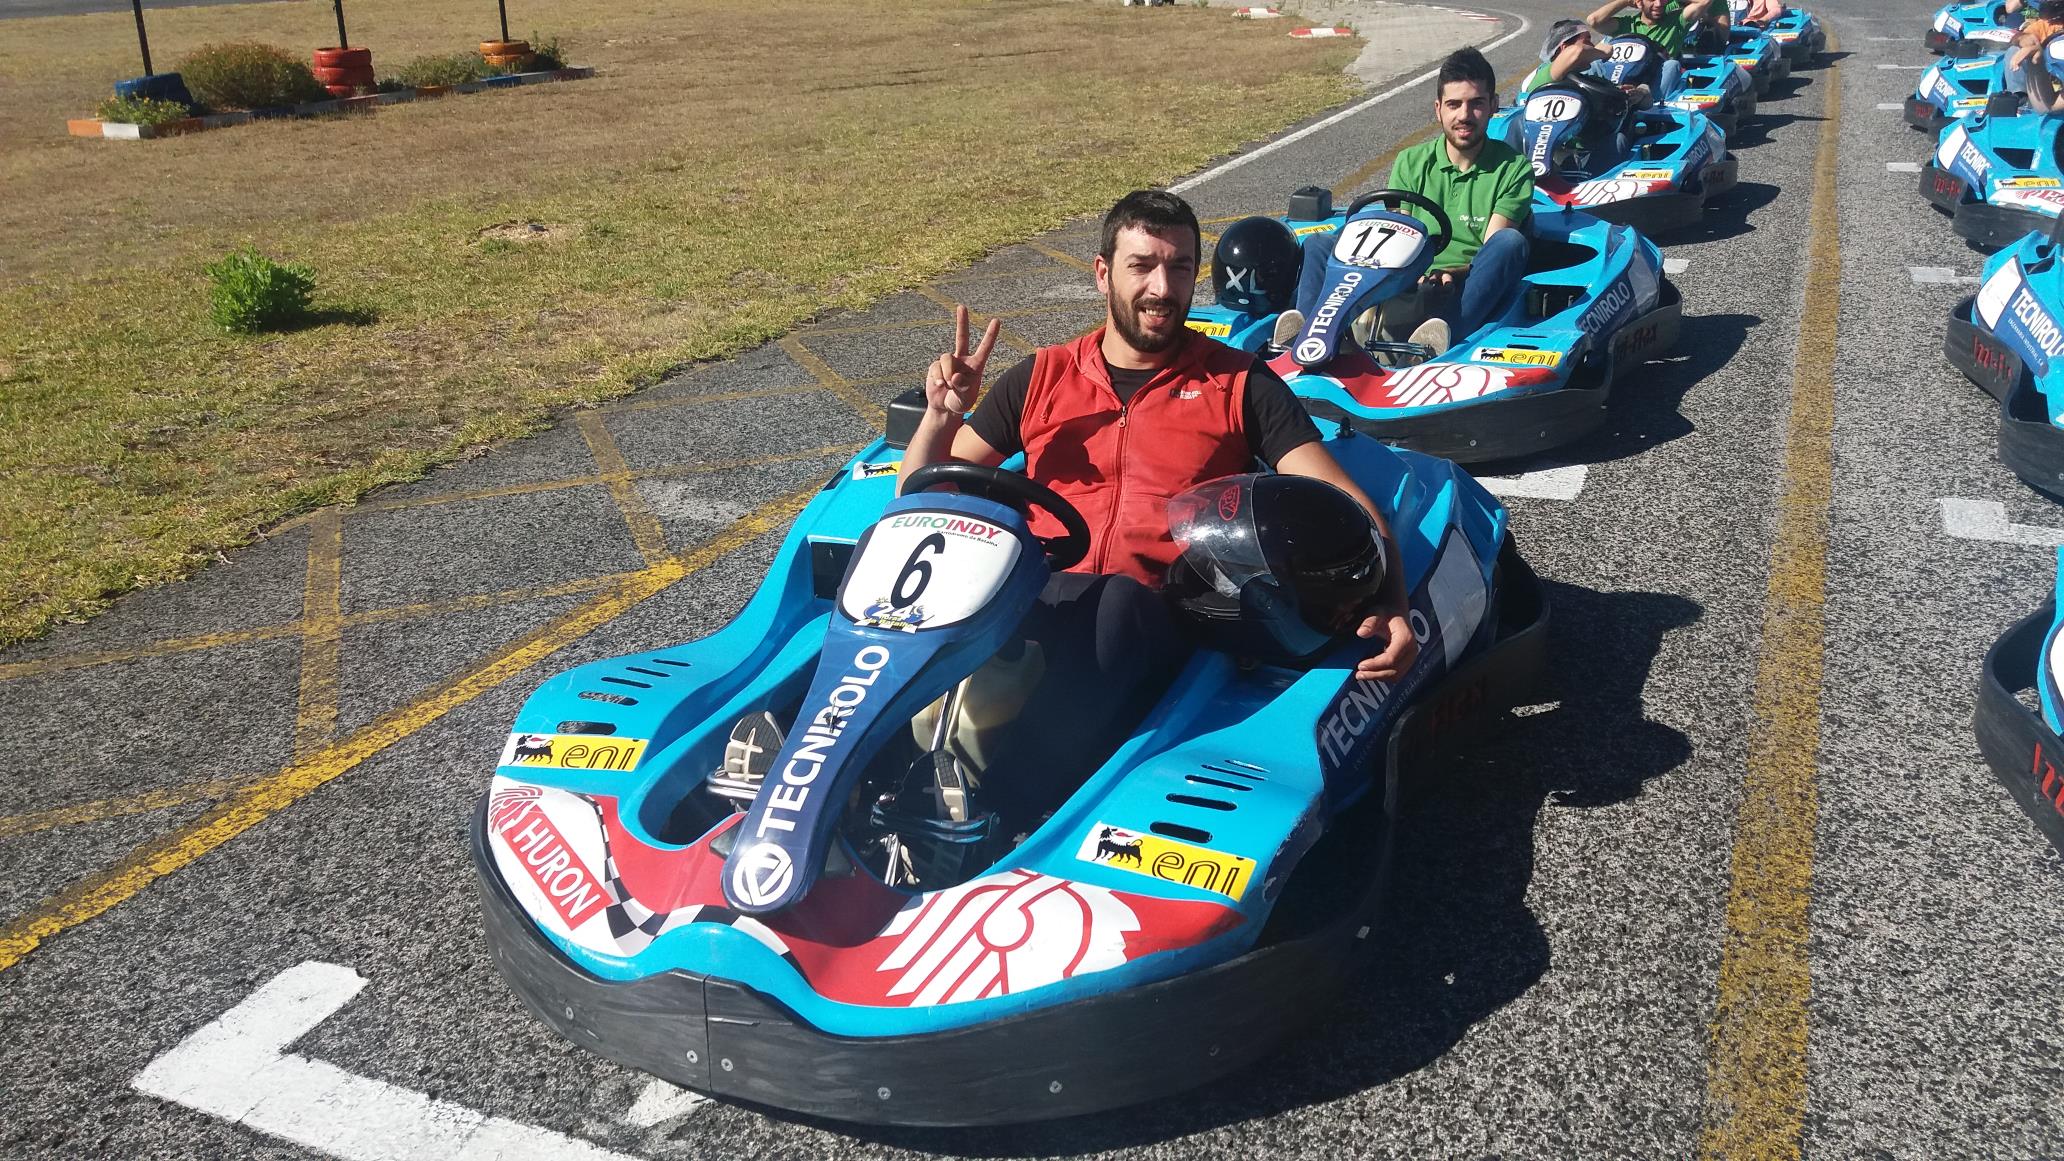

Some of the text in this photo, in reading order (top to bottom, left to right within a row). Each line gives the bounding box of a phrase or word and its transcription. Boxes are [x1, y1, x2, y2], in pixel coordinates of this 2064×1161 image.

[1611, 45, 1634, 60] 30
[1543, 99, 1566, 118] 10
[1531, 124, 1554, 162] TECNIROLO
[1351, 226, 1397, 259] 17
[1358, 219, 1420, 236] EUROINDY
[1226, 265, 1267, 295] XL
[1307, 271, 1363, 337] TECNIROLO
[1510, 351, 1556, 366] eni
[891, 515, 1003, 541] EUROINDY
[889, 531, 946, 609] 6
[560, 738, 640, 771] eni
[755, 644, 890, 839] TECNIROLO
[512, 817, 601, 920] HURON
[1151, 856, 1245, 896] eni
